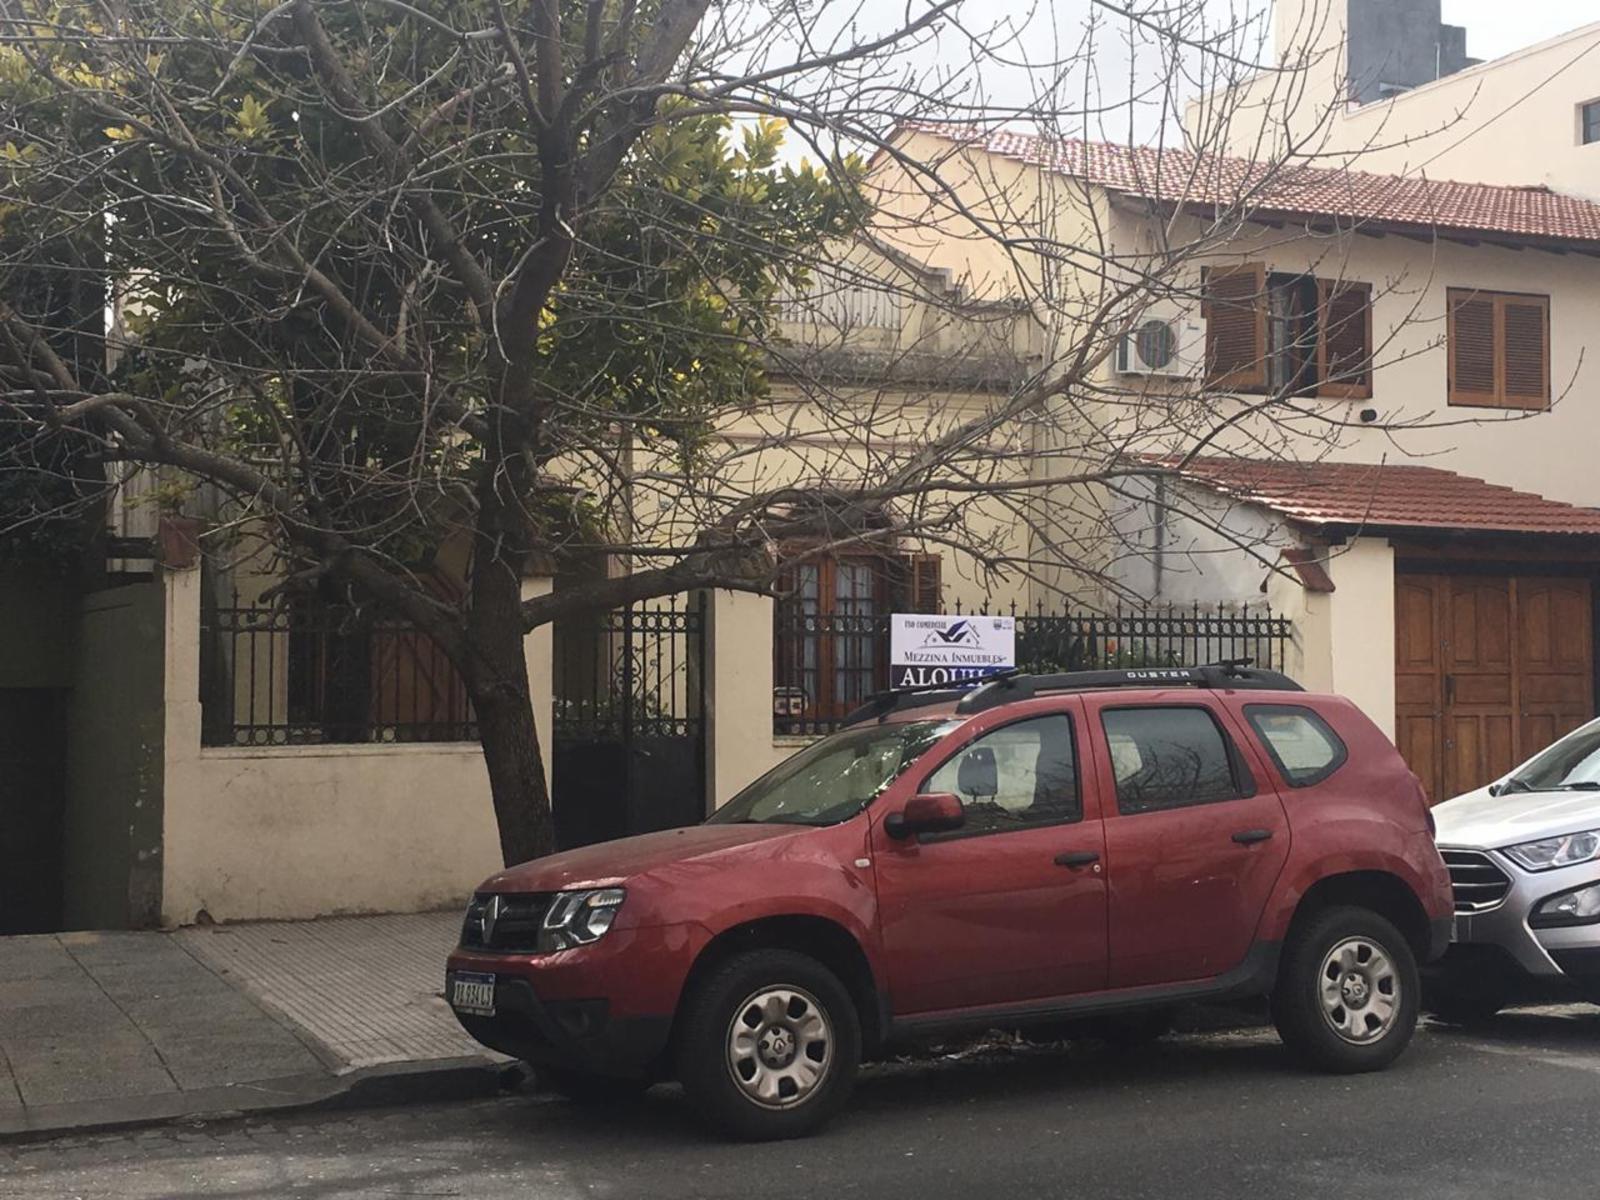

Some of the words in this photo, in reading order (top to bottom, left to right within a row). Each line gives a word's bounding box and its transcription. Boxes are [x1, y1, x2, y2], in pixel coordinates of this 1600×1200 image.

[904, 651, 948, 663] MEZZINA
[951, 652, 1003, 664] INMUEBLES
[900, 667, 1003, 687] ALQUIL
